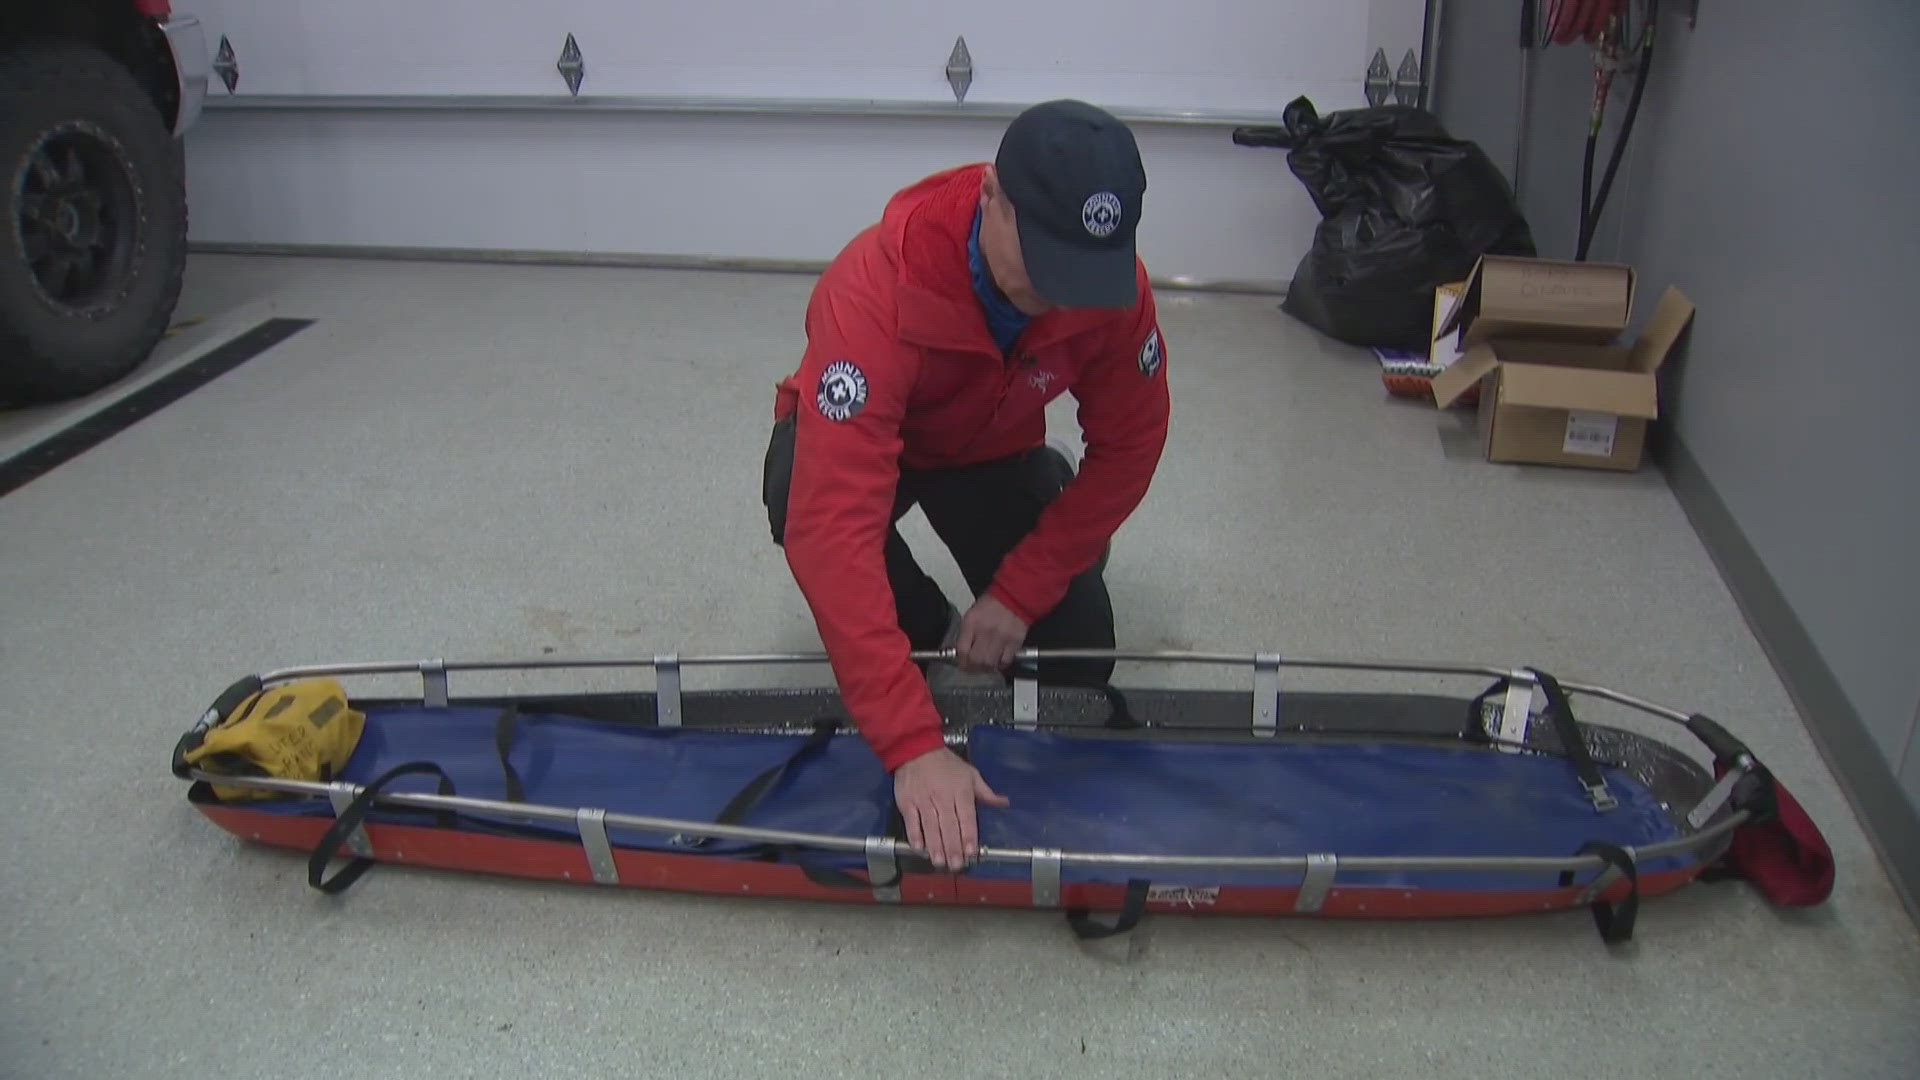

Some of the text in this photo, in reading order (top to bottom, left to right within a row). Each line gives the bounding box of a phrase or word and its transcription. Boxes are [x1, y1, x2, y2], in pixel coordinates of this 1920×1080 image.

[1085, 192, 1120, 216] MOUNTAIN
[1087, 219, 1115, 237] RESCUE
[821, 360, 867, 404] MOUNTAIN
[817, 393, 851, 421] RESCUE
